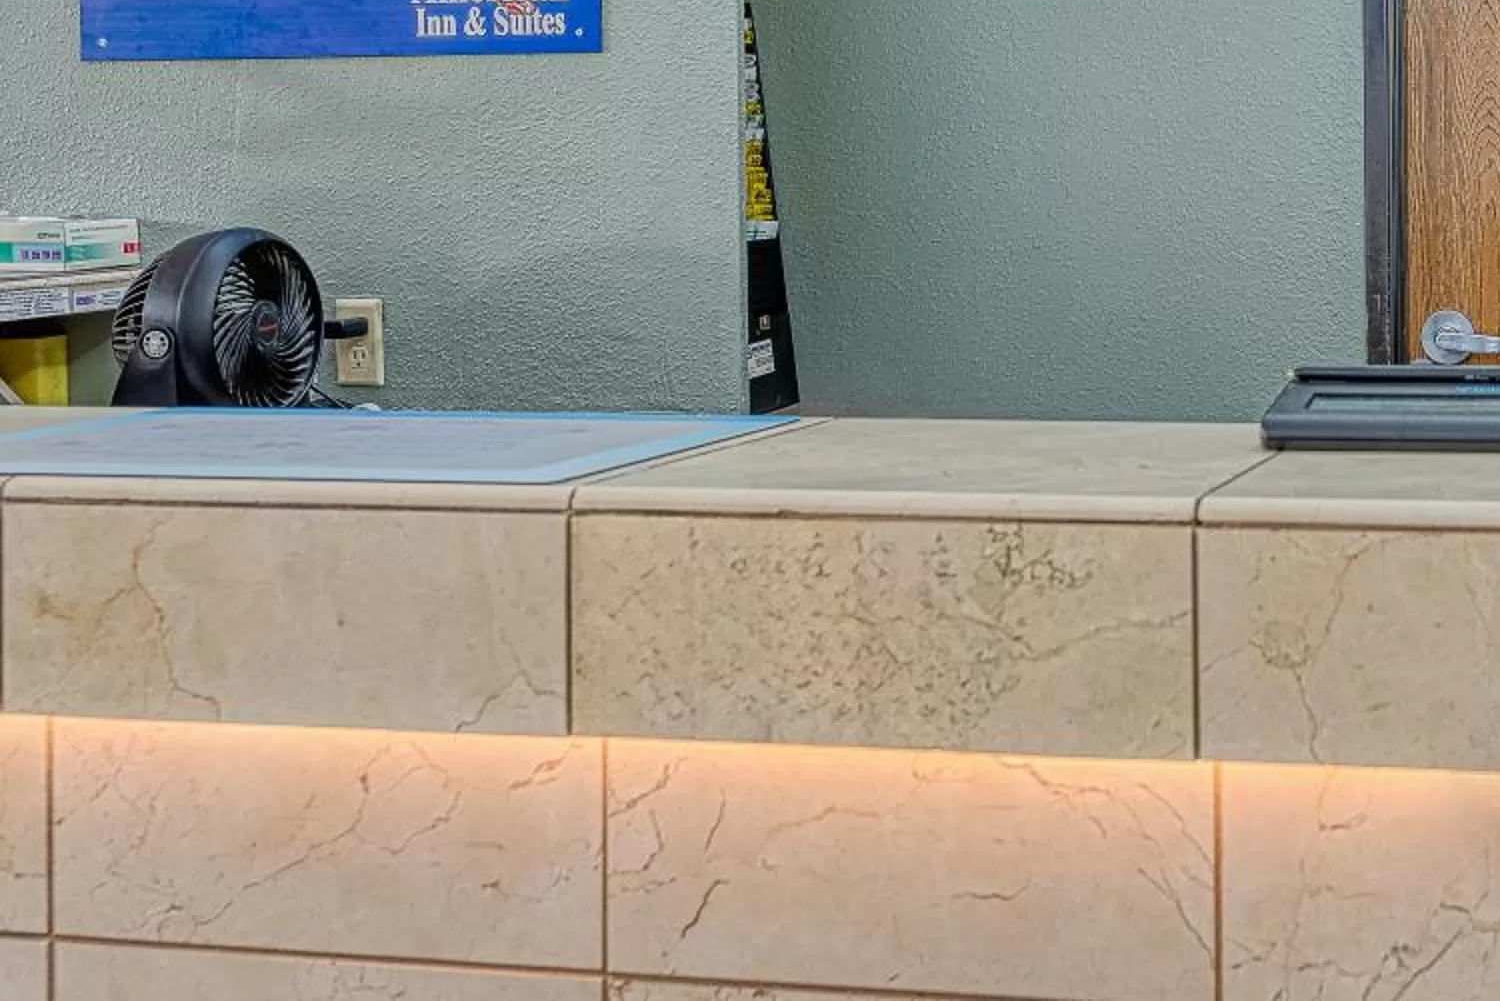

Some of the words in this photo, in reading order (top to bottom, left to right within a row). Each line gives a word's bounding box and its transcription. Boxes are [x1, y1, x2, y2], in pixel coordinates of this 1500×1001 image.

[415, 7, 457, 37] Inn
[463, 6, 487, 36] &
[493, 6, 567, 37] Suites
